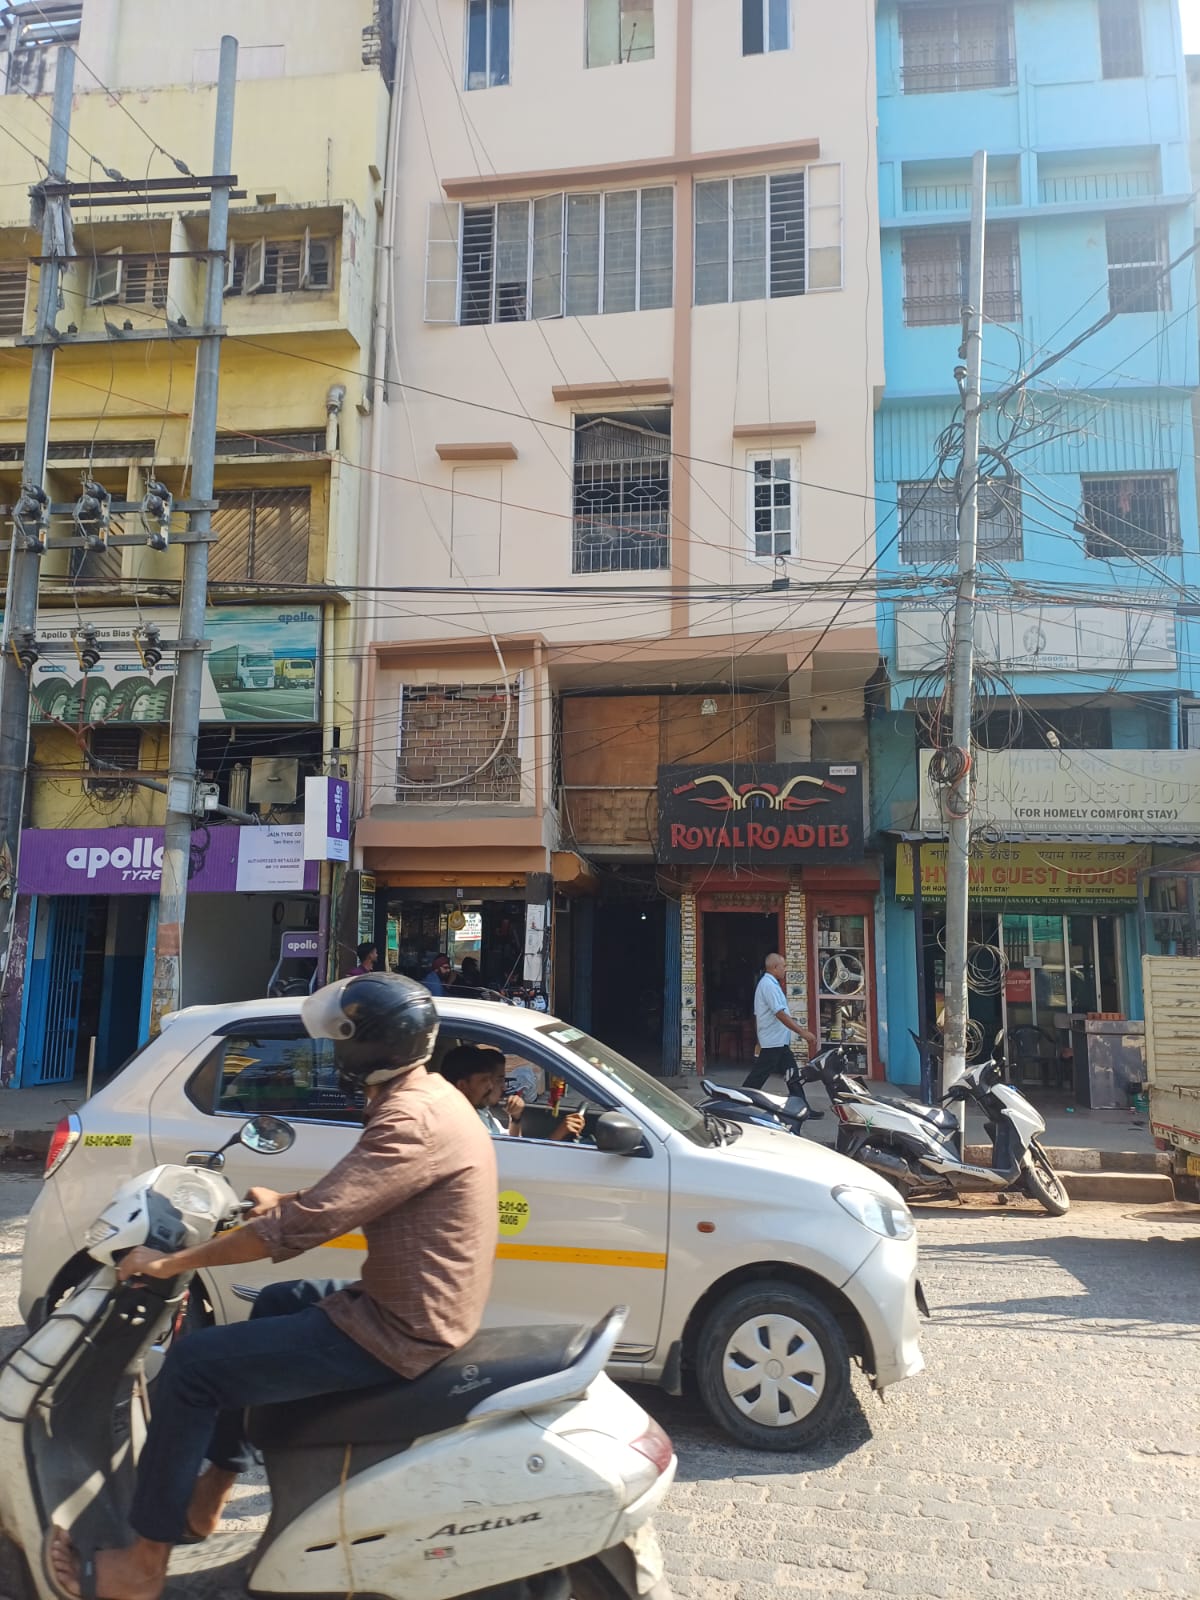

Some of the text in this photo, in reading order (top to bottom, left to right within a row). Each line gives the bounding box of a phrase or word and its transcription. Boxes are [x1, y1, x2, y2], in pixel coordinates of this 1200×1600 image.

[278, 611, 314, 624] apollo
[41, 631, 67, 639] Apollo
[1064, 783, 1139, 804] GUEST
[334, 784, 343, 833] apollo
[1014, 808, 1179, 820] (FOR HOMELY COMFORT STAY)
[671, 822, 850, 850] ROYAL ROADIES
[122, 870, 162, 881] TYRE
[992, 867, 1060, 885] GUEST
[288, 940, 318, 952] apollo
[960, 1165, 986, 1174] HONDA
[498, 1201, 528, 1213] S-01-QC
[500, 1215, 519, 1225] 4006
[416, 1511, 543, 1542] Activa
